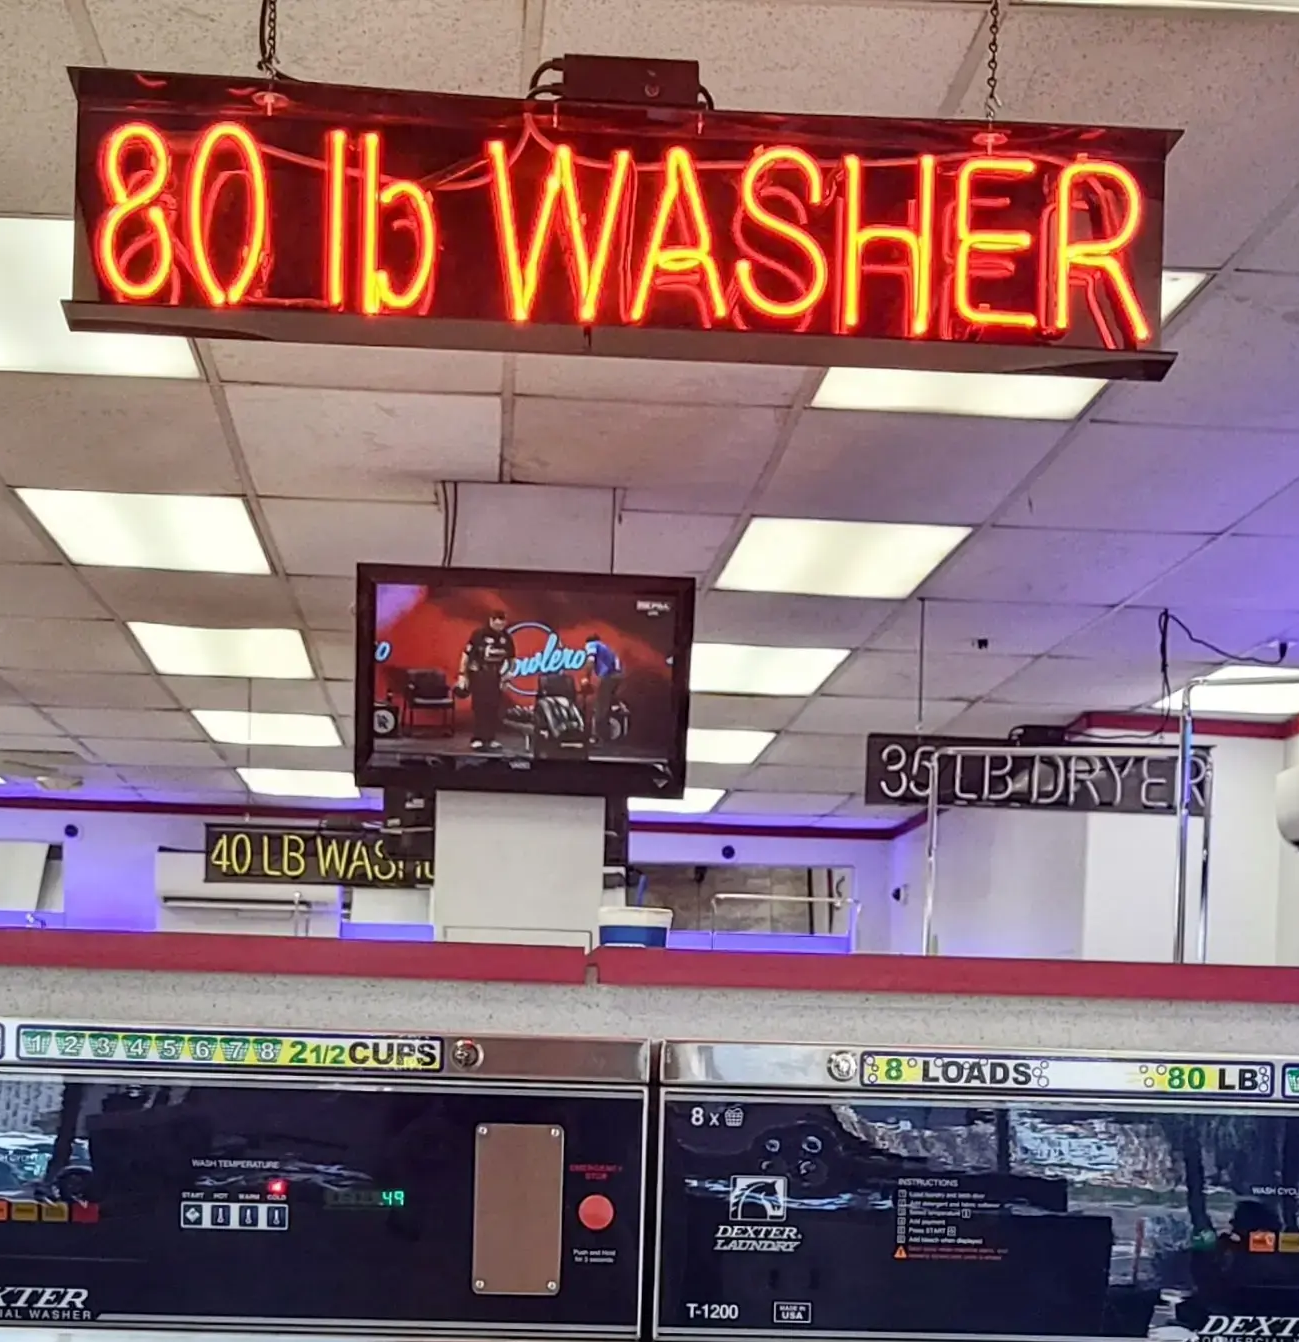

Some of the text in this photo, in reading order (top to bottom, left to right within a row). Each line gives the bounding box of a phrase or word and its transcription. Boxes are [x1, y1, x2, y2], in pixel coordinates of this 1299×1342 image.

[99, 122, 1152, 342] 80 lb WASHER
[880, 744, 1209, 808] 35 LB DRYER
[210, 833, 252, 876] 40
[262, 834, 306, 877] LB
[29, 1036, 42, 1053] 1
[62, 1037, 77, 1054] 2
[96, 1037, 110, 1055] 3
[128, 1038, 144, 1057] 4
[162, 1039, 176, 1058] 5
[196, 1040, 210, 1059] 6
[230, 1041, 243, 1060] 7
[260, 1041, 274, 1061] 8
[348, 1041, 437, 1068] CUPS
[885, 1057, 1259, 1091] 8 LOADS 80 LB
[691, 1107, 720, 1126] 8 x
[191, 1159, 280, 1169] WASH TEMPERATURE
[897, 1178, 959, 1188] INSTRUCTIONS
[715, 1225, 799, 1239] DEXTER
[713, 1239, 801, 1252] LAUNDRY
[29, 1308, 92, 1321] WASHER
[686, 1303, 739, 1320] T-1200
[781, 1310, 803, 1320] USA
